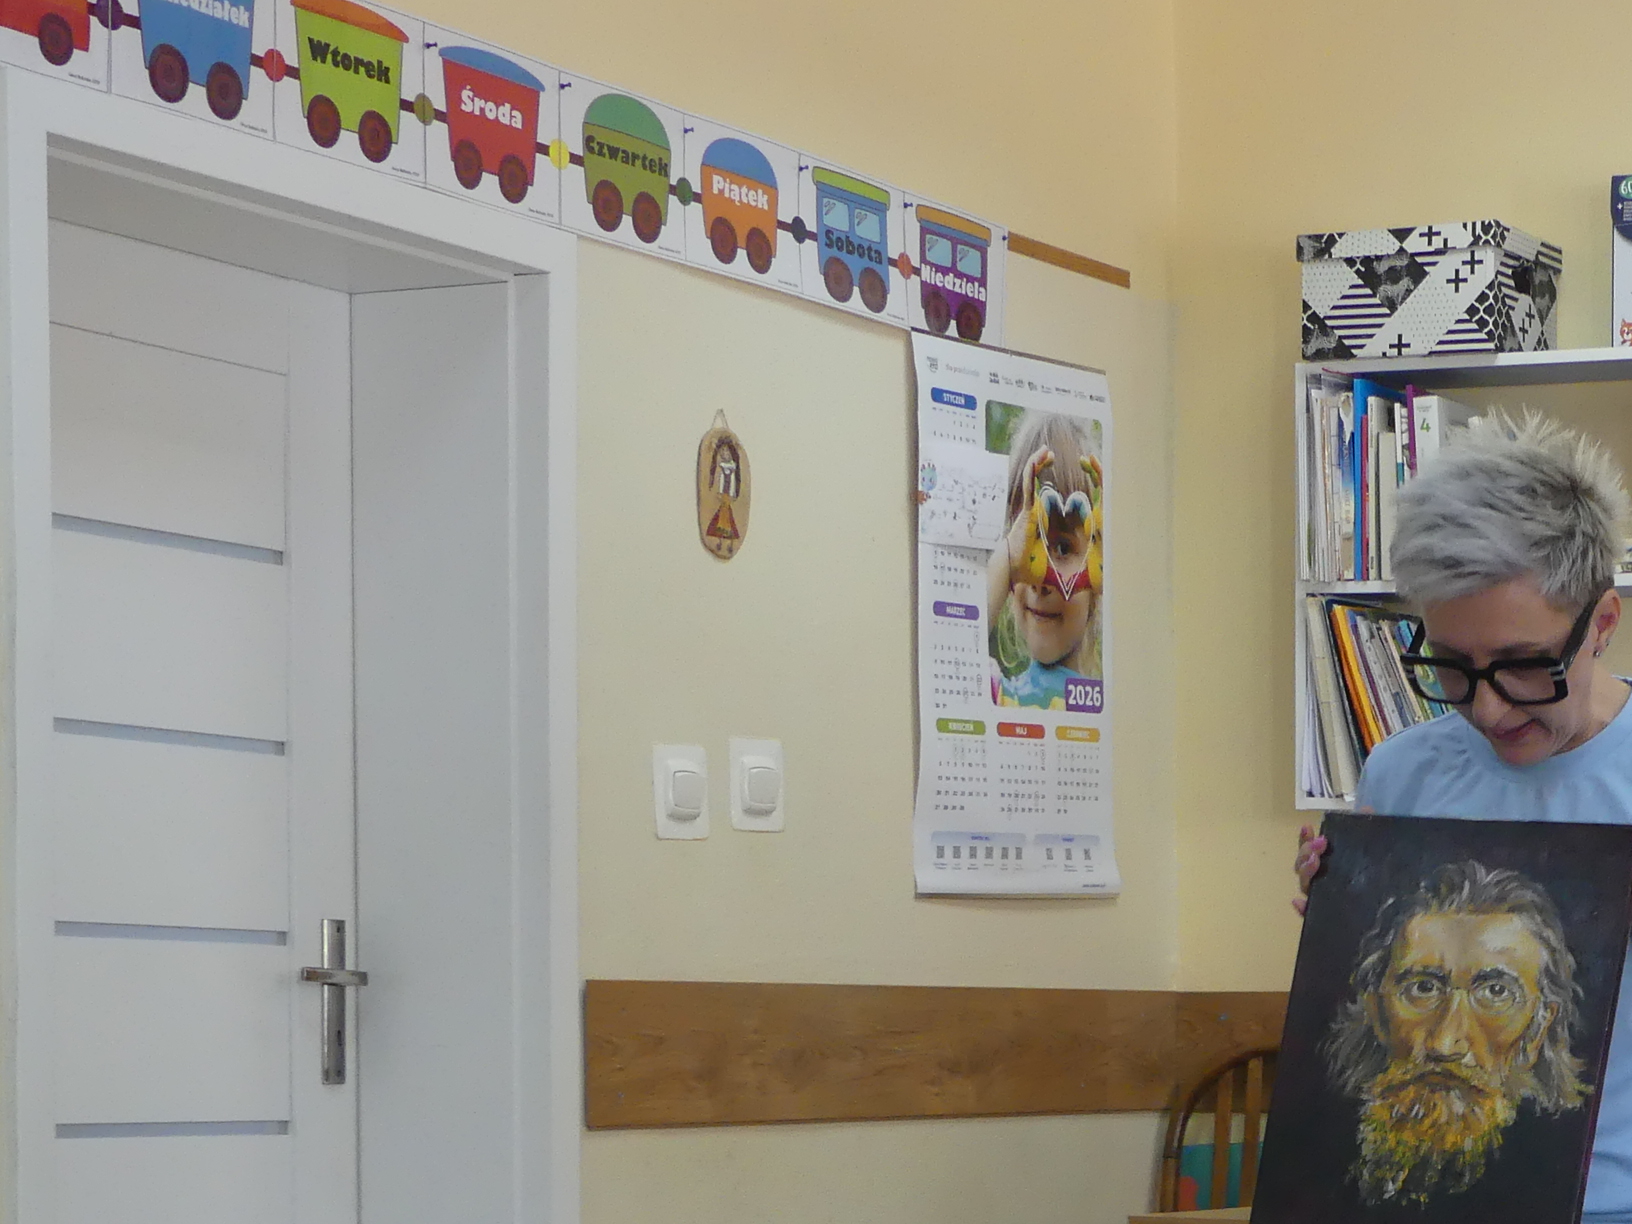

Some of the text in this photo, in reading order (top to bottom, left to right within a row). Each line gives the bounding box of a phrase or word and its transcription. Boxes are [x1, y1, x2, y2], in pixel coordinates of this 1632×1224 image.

[308, 37, 390, 84] Wtorek
[460, 85, 522, 129] Środa
[585, 134, 669, 178] Czwartek
[712, 174, 768, 211] Piątek
[824, 229, 883, 265] Sobota
[920, 263, 987, 301] Niedziela
[1420, 418, 1431, 432] 4
[1068, 684, 1101, 707] 2026
